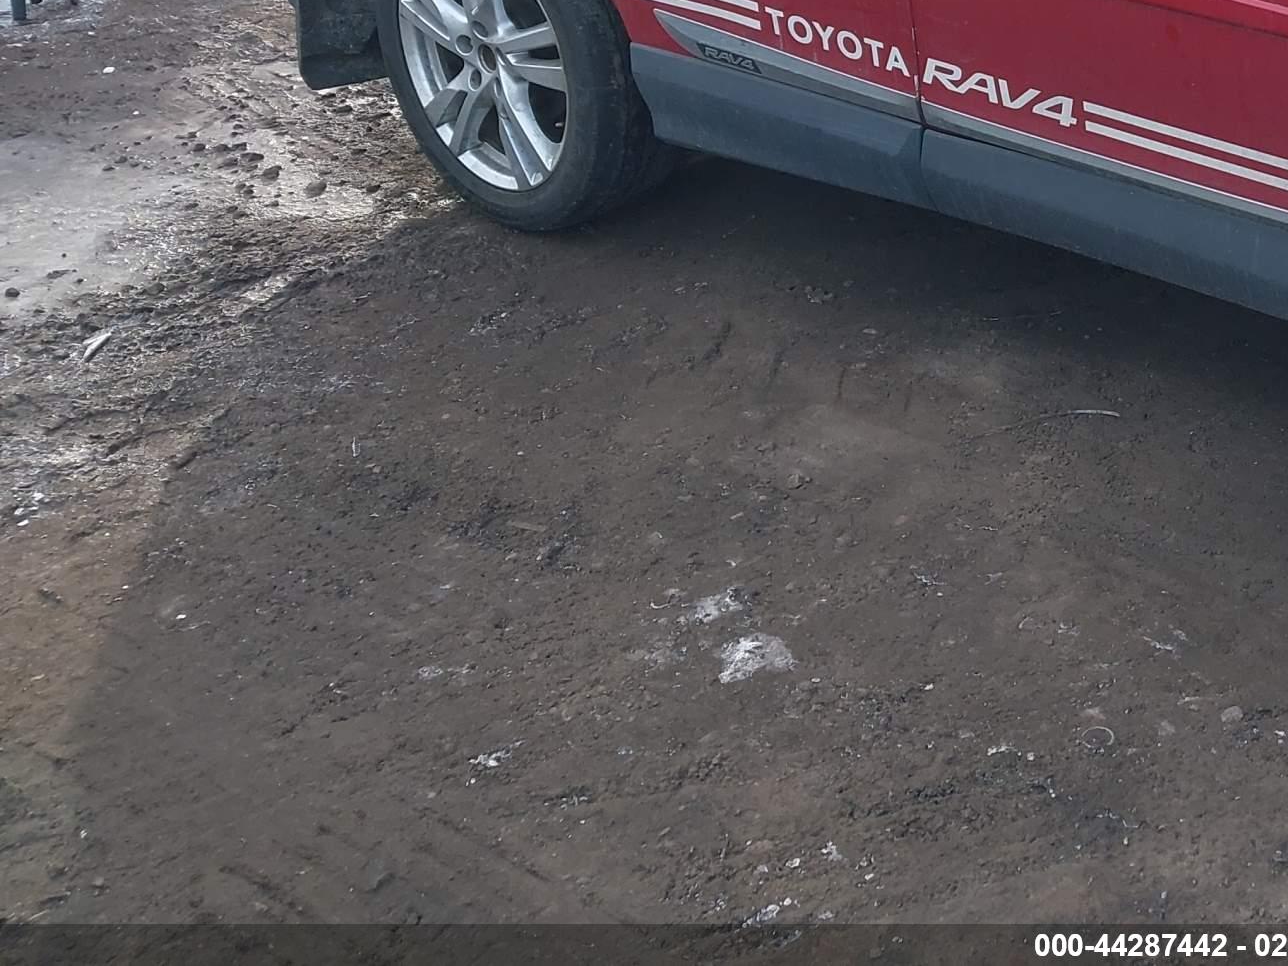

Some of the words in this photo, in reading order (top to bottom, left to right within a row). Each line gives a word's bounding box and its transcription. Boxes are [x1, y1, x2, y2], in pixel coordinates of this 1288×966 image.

[704, 46, 755, 70] RAV4
[764, 6, 911, 77] TOYOTA
[922, 57, 1078, 127] RAV4
